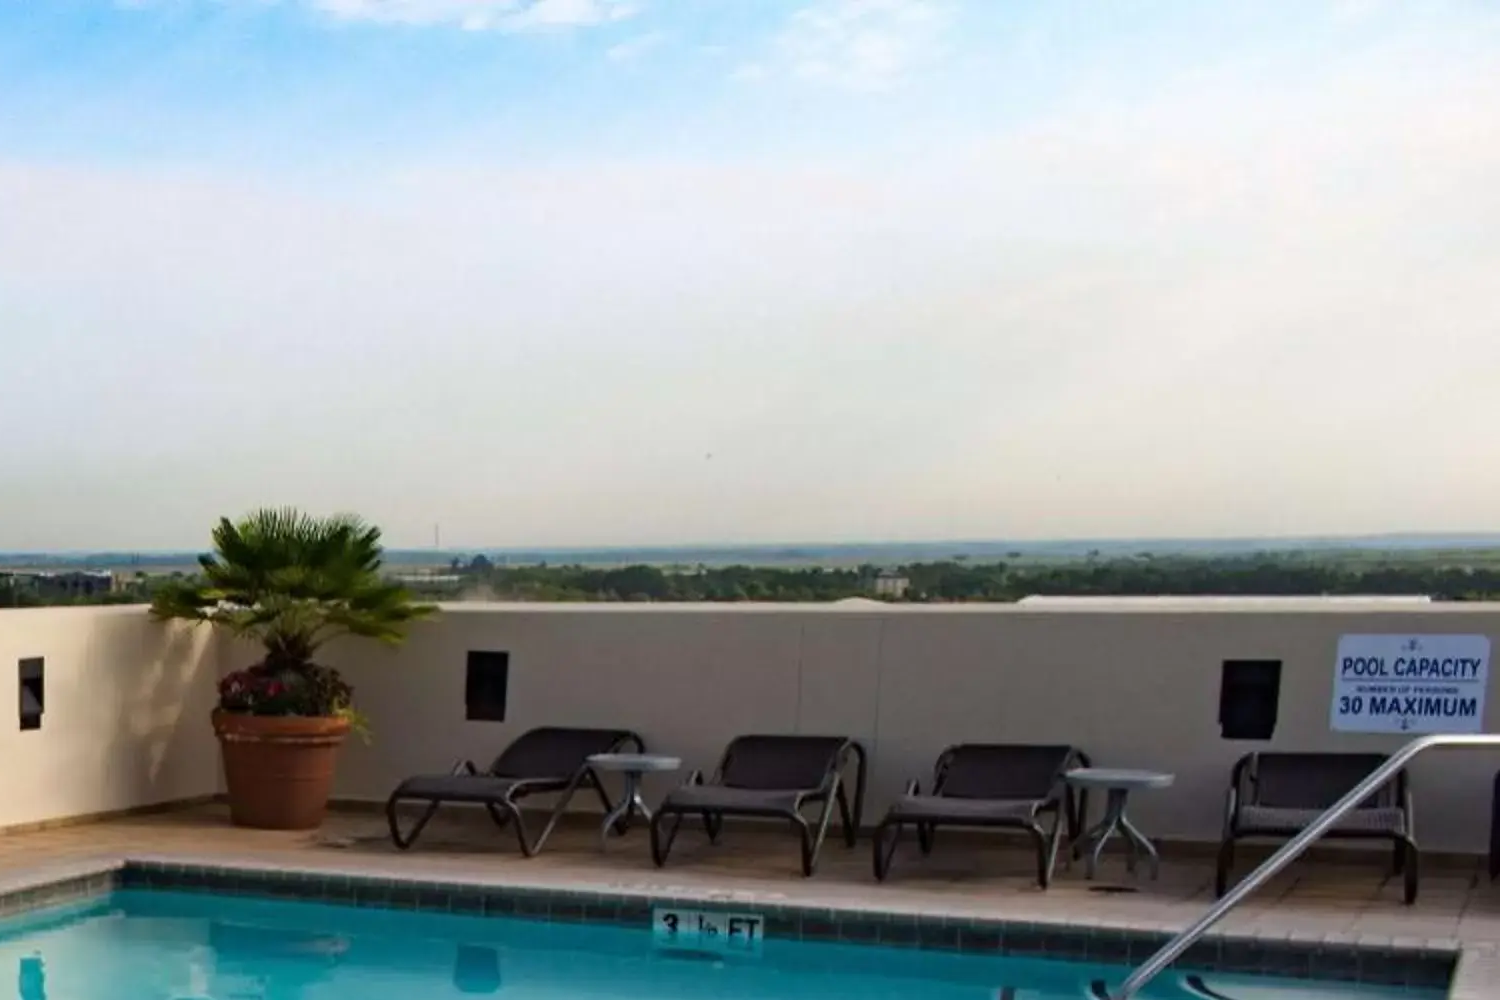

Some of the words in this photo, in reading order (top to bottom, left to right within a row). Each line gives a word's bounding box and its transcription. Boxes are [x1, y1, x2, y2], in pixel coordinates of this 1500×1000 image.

[1342, 657, 1388, 676] POOL
[1394, 658, 1481, 677] CAPACITY
[1339, 696, 1363, 715] 30
[1369, 696, 1476, 717] MAXIMUM
[729, 917, 760, 938] FT
